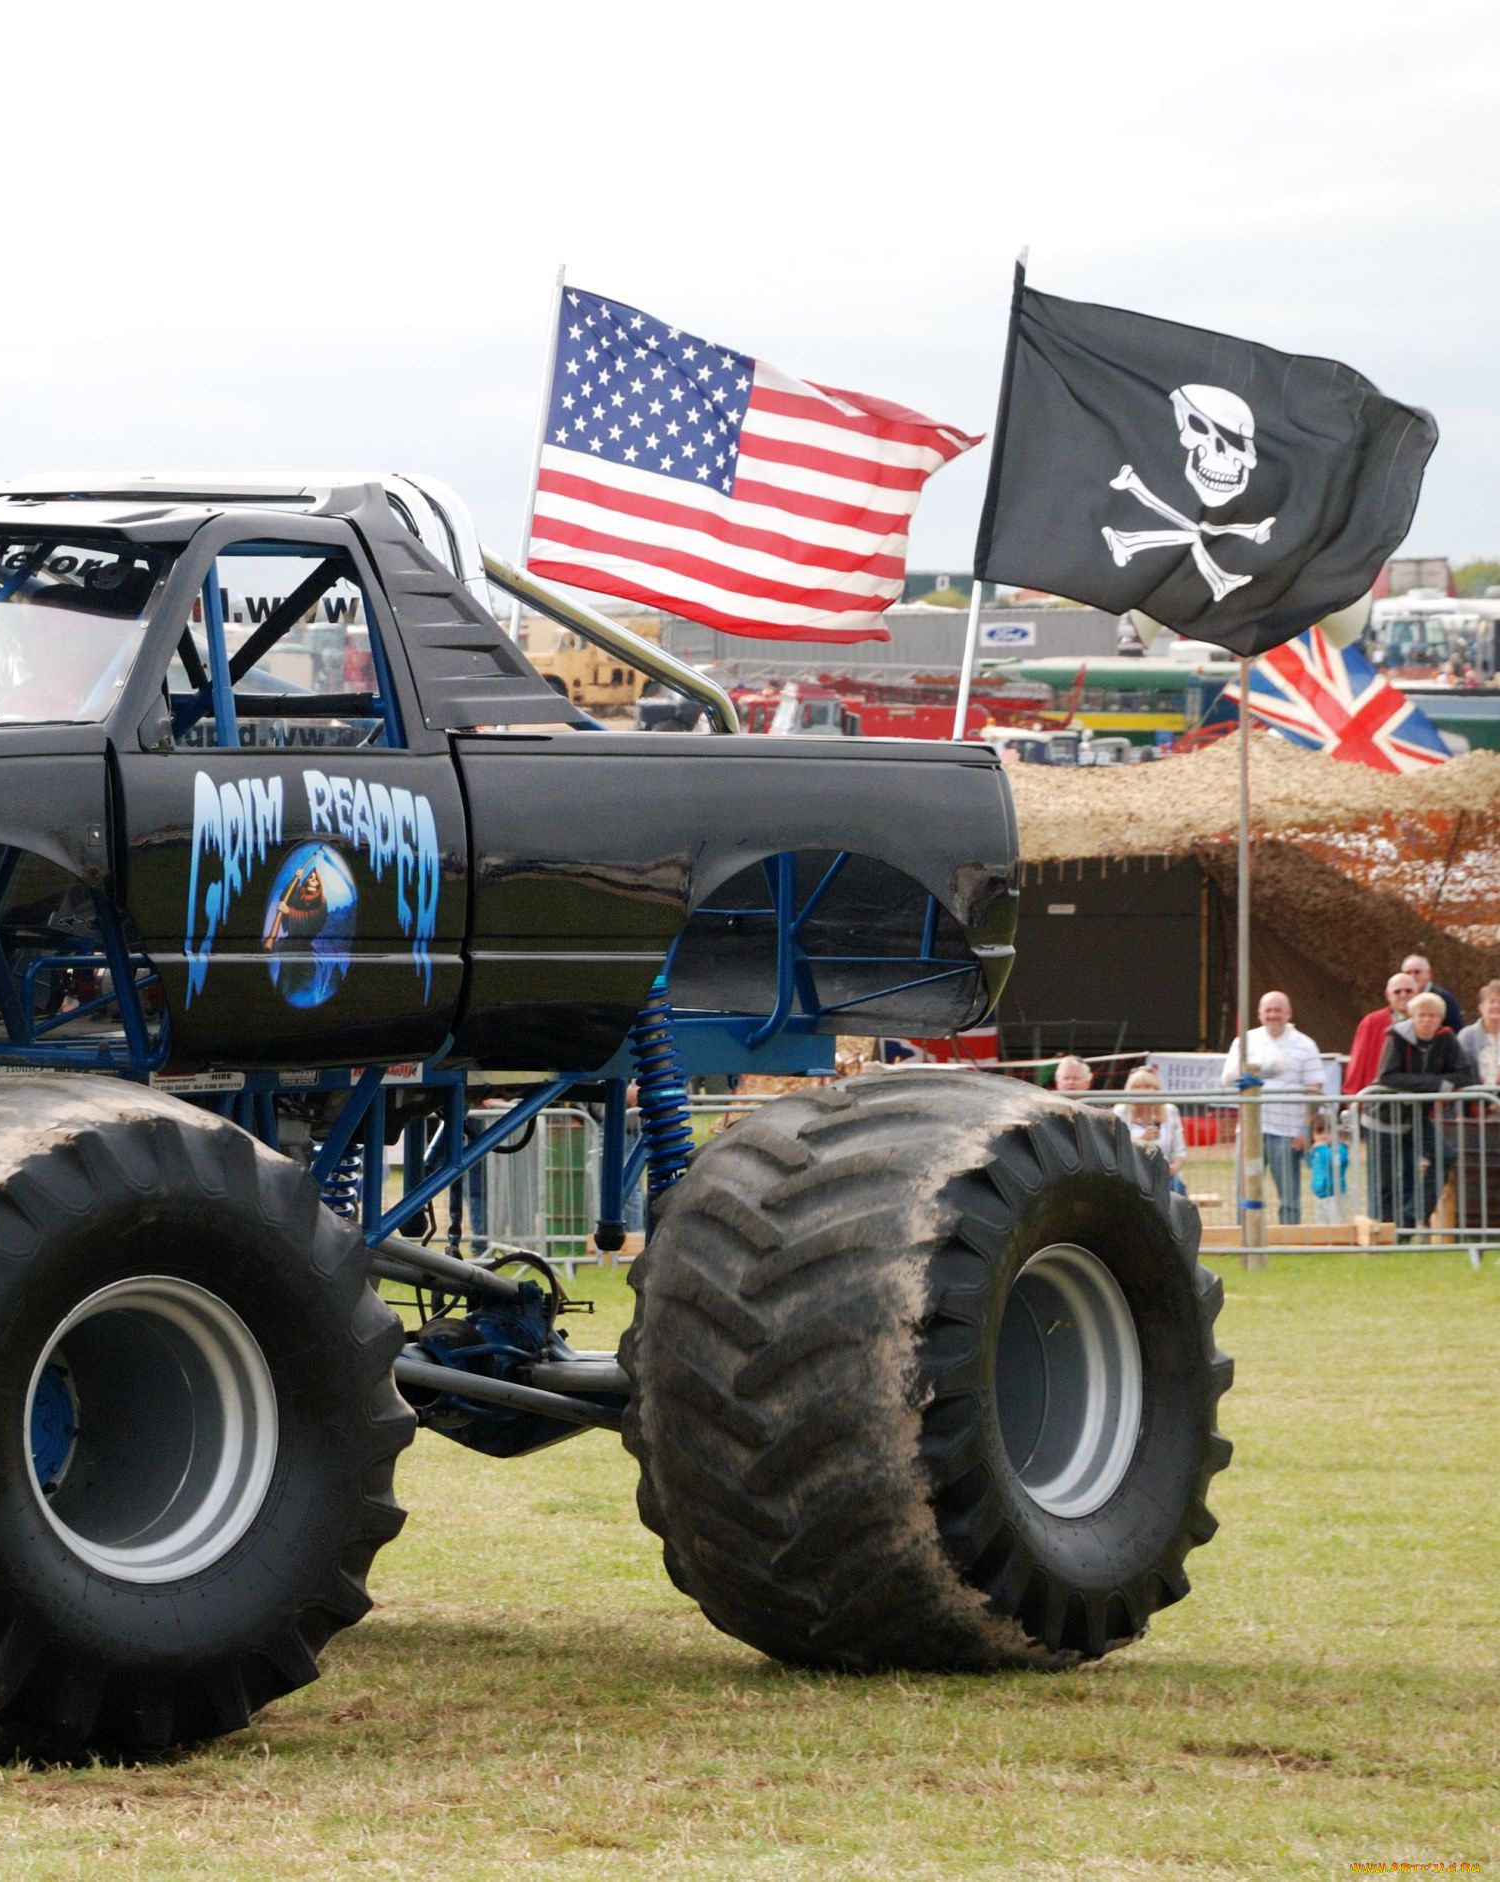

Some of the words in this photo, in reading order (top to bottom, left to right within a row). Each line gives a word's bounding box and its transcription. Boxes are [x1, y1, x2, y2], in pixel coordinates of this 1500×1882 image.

[186, 771, 283, 1009] GRIM
[303, 770, 440, 1006] REAPER
[1168, 1063, 1205, 1077] HELP
